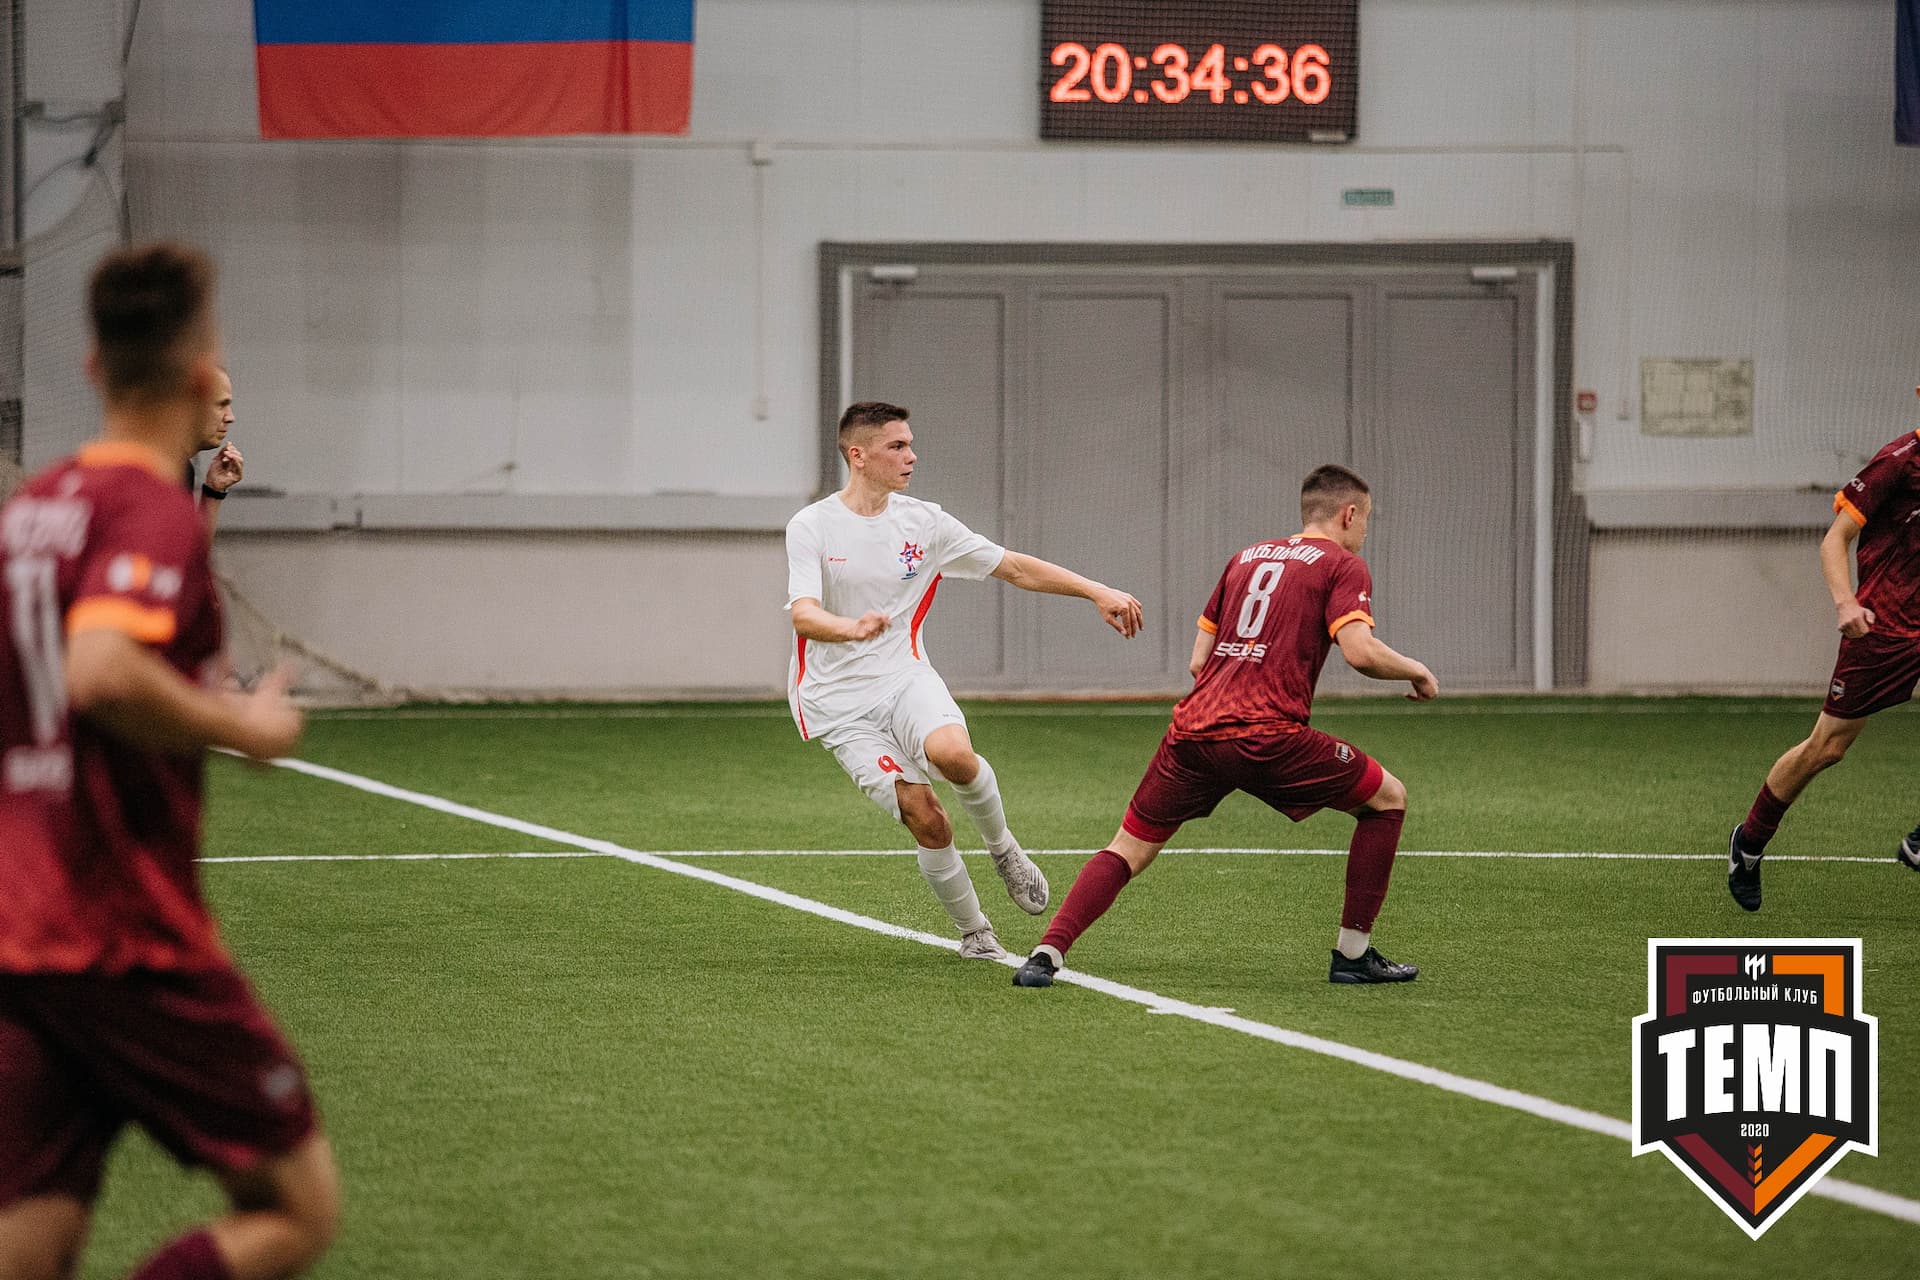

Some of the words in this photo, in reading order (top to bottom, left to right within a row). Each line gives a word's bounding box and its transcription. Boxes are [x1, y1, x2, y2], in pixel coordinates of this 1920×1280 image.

[1050, 42, 1331, 104] 20:34:36
[1236, 562, 1285, 638] 8
[878, 755, 904, 773] 9
